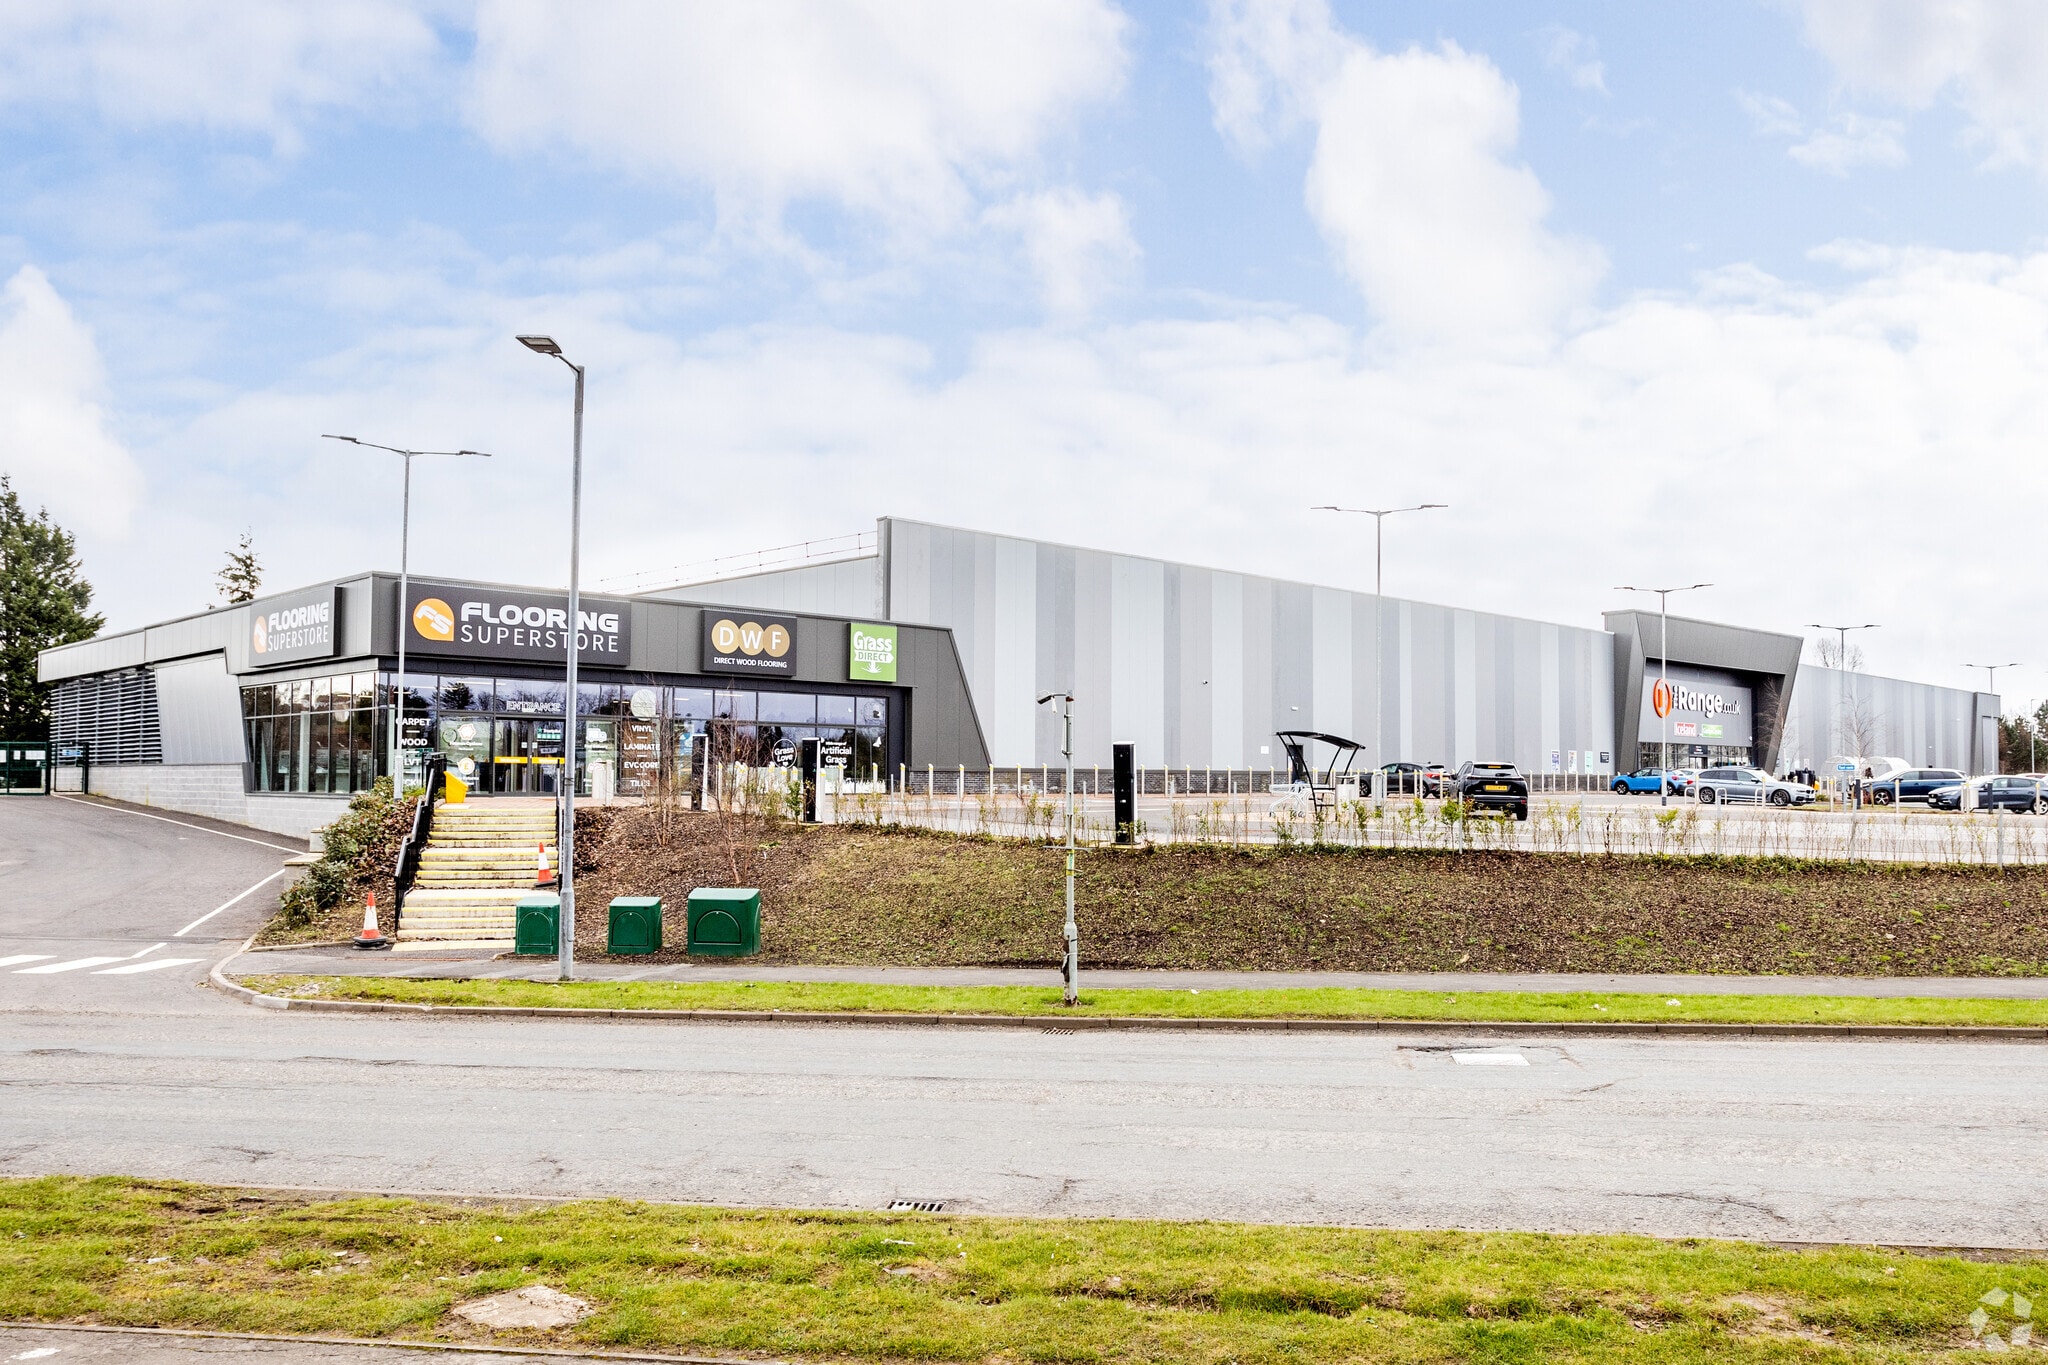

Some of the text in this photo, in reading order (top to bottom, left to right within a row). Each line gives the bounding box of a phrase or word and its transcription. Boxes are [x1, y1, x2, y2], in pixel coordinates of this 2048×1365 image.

[268, 602, 329, 633] FLOORING
[460, 601, 619, 633] FLOORNG
[268, 625, 329, 652] SUPERSTORE
[853, 631, 893, 652] Grass
[714, 656, 787, 668] DIRECT WOOD FLOORING
[858, 651, 889, 662] DIRECT
[631, 724, 654, 733] VINYL
[623, 743, 660, 751] LAMINATE
[820, 746, 852, 755] Artificial
[825, 756, 847, 764] Grass
